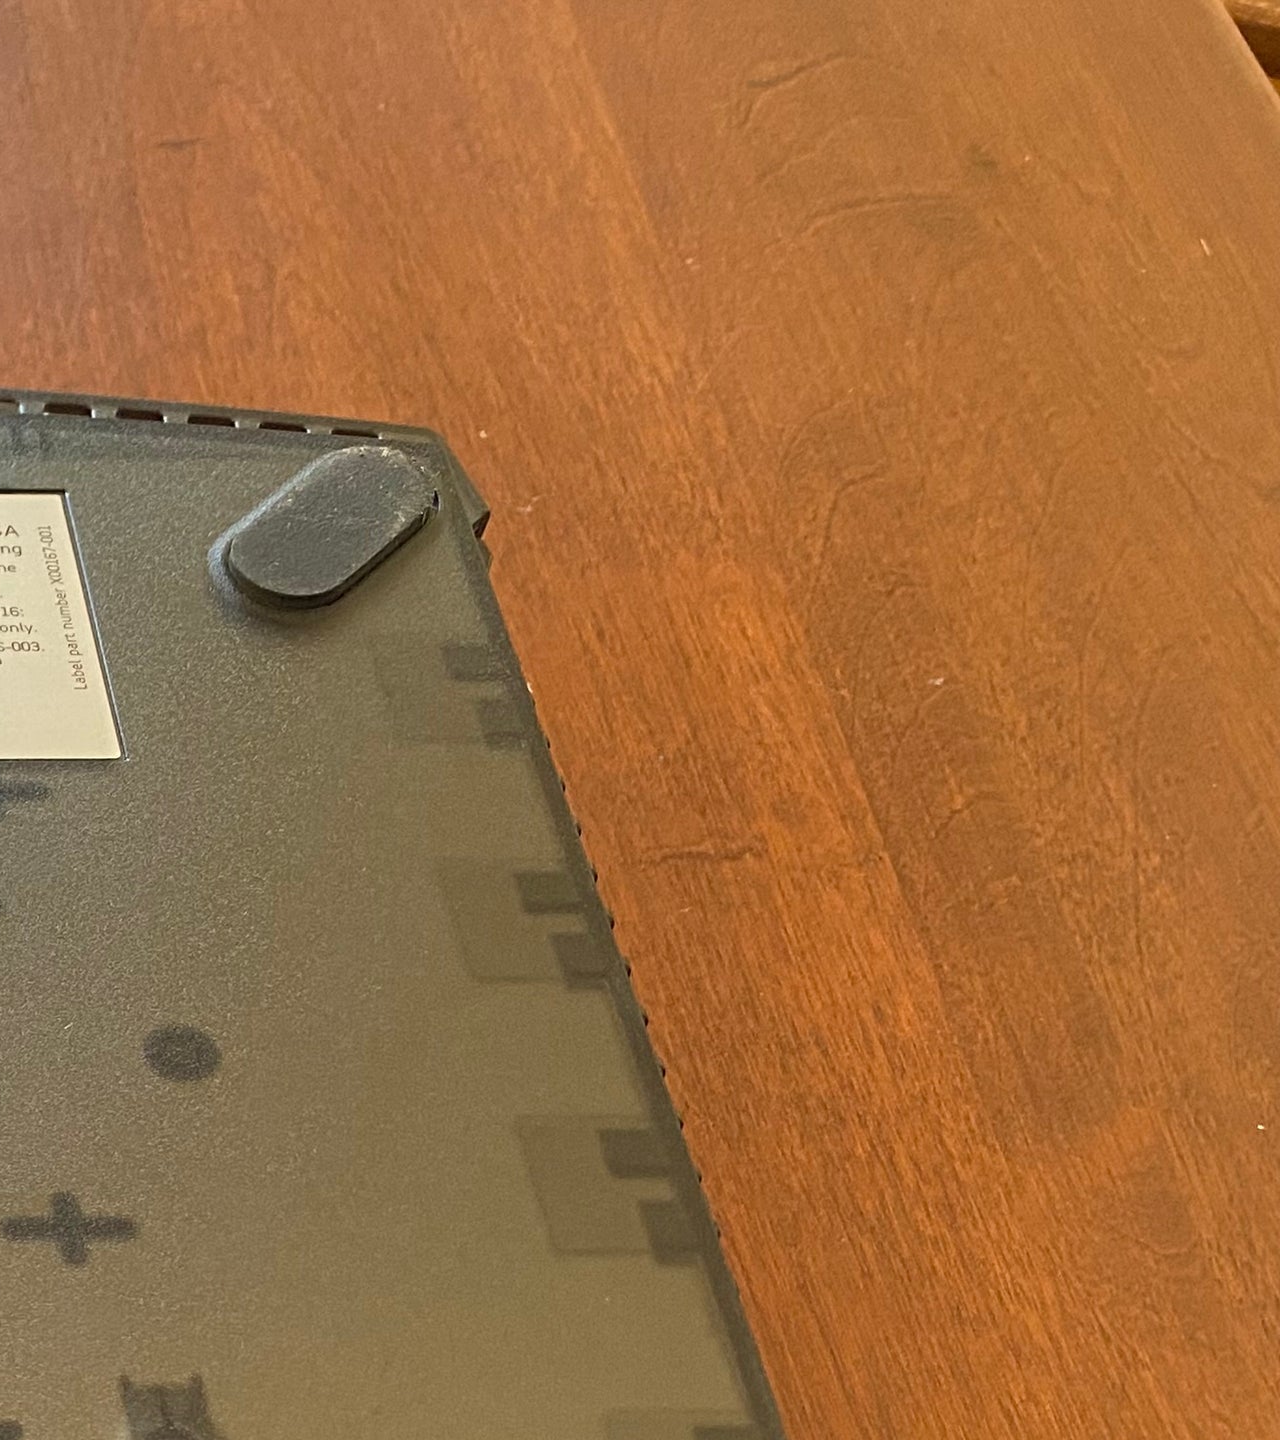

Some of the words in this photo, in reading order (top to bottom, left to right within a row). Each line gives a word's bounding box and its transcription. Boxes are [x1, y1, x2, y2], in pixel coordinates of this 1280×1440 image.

[55, 589, 74, 630] number
[0, 622, 38, 635] only.
[65, 633, 84, 656] part
[68, 661, 88, 690] Label
